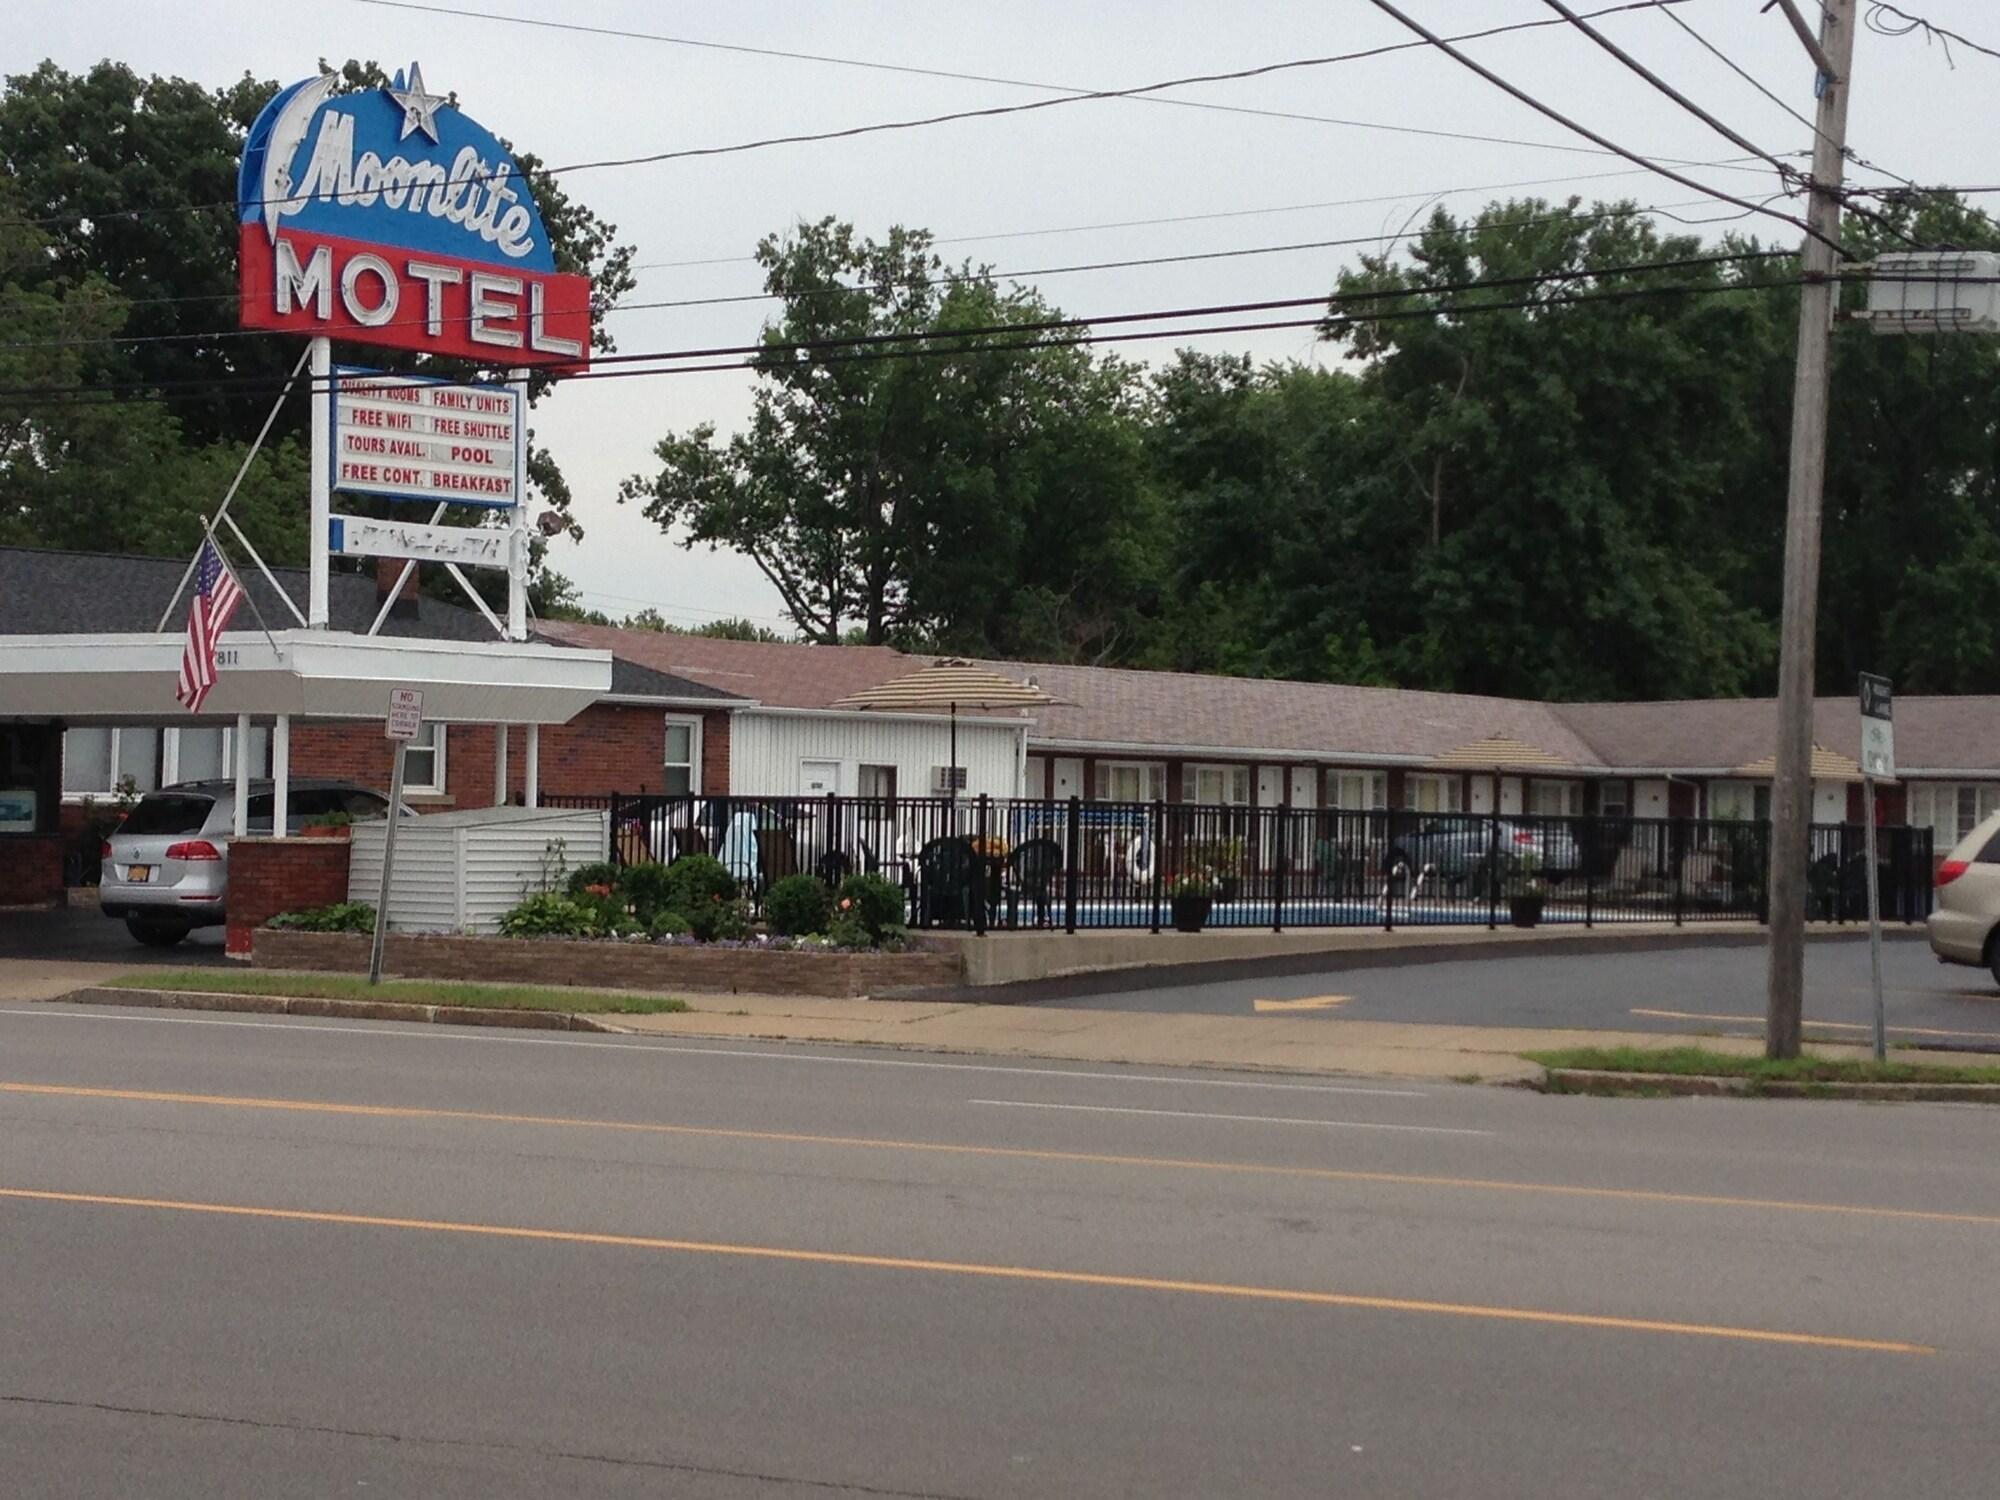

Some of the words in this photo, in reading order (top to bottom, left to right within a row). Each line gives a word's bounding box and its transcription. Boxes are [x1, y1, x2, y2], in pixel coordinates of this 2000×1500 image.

[278, 109, 534, 257] Moonlite
[275, 238, 583, 358] MOTEL
[433, 391, 472, 409] FAMILY
[477, 395, 510, 413] UNITS
[352, 408, 382, 426] FREE
[387, 413, 412, 429] WIFI
[434, 418, 460, 434] FREE
[464, 421, 510, 440] SHUTTLE
[347, 435, 385, 452] TOURS
[390, 441, 426, 458] AVAIL.
[451, 446, 493, 464] POOL
[342, 464, 377, 481] FREE
[383, 469, 424, 487] CONT.
[433, 473, 511, 493] BREAKFAST
[215, 650, 238, 665] 811
[400, 691, 414, 703] NO
